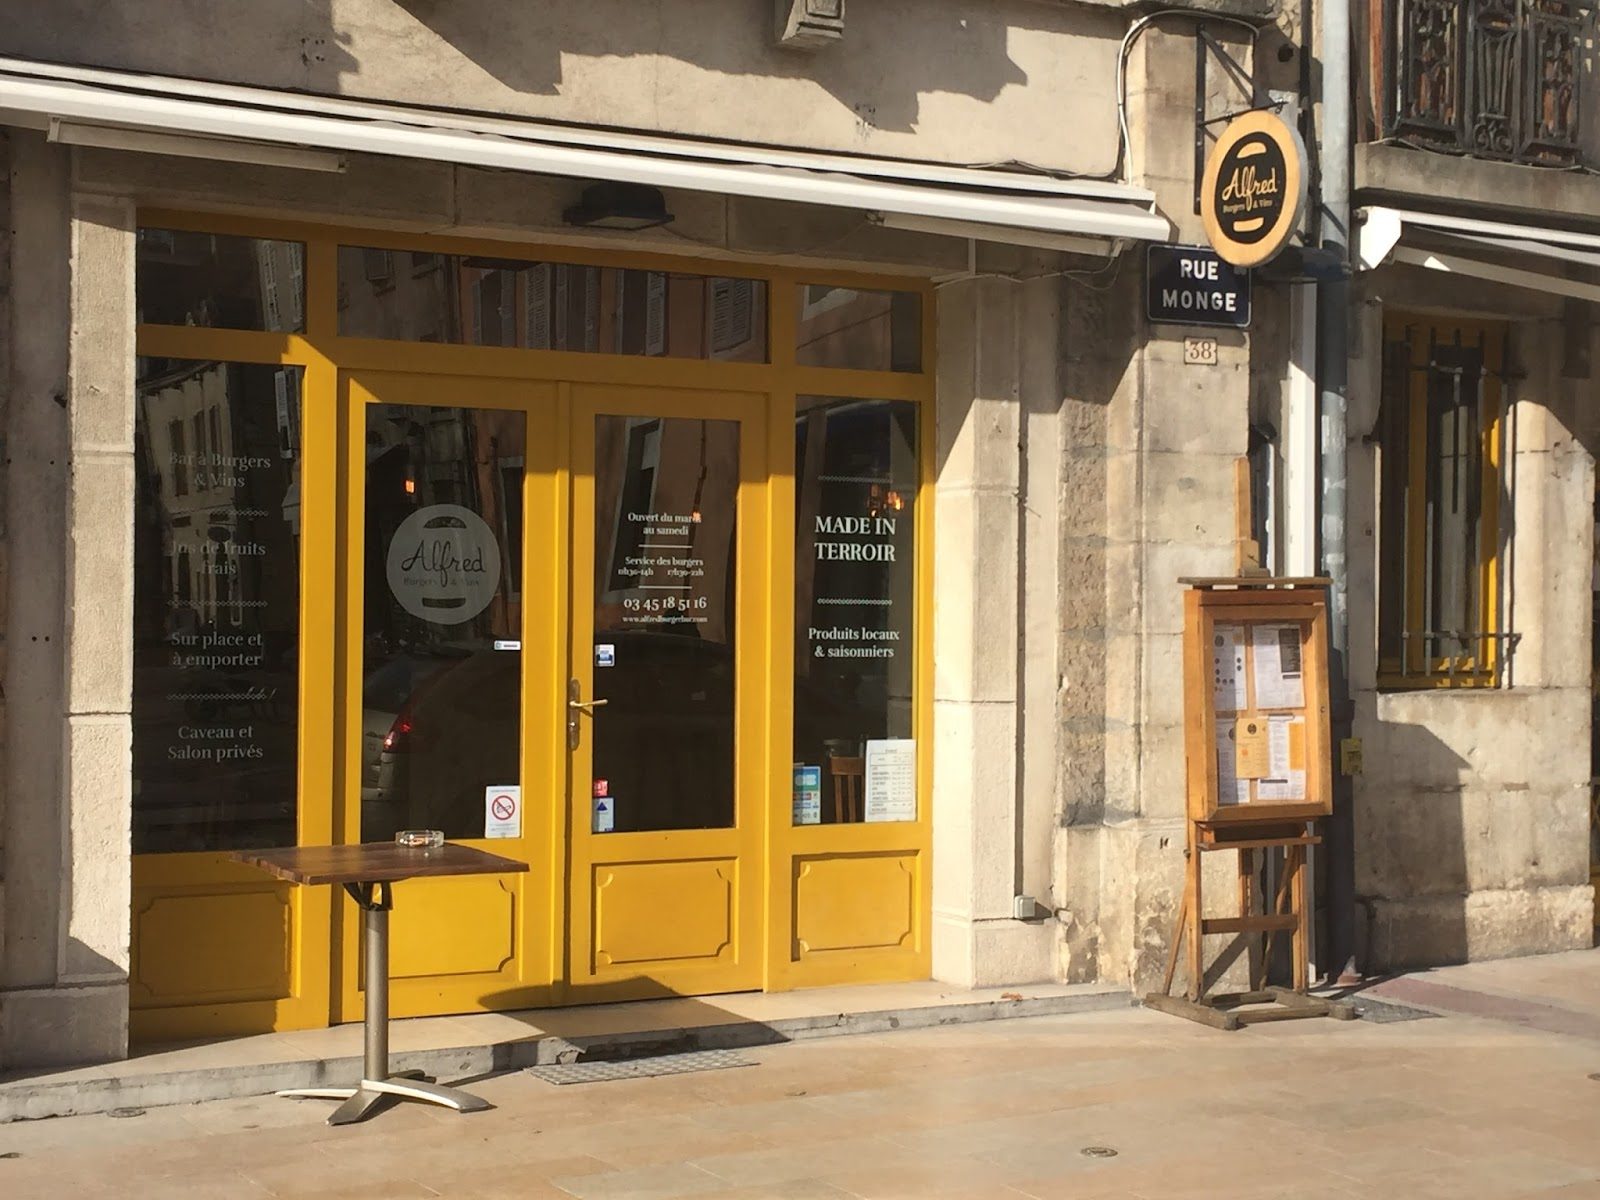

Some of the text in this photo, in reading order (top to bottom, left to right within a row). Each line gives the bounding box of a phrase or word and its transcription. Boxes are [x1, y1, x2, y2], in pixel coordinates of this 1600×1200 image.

[1221, 164, 1278, 212] Alfred
[1180, 258, 1219, 281] RUE
[1162, 288, 1237, 312] MONGE
[1188, 341, 1213, 361] 38
[212, 453, 272, 472] Burgers
[194, 472, 246, 488] & Vins
[627, 511, 659, 523] Ouvert
[660, 512, 673, 523] du
[814, 515, 897, 536] MADE IN
[643, 525, 689, 536] au samedi
[224, 540, 267, 556] fruits
[814, 542, 897, 562] TERROIR
[201, 560, 237, 575] frais
[400, 539, 487, 588] Alfred
[625, 555, 704, 568] Service des burgers
[623, 596, 708, 612] 03 45 18 51 16
[170, 631, 263, 650] Sur place et
[808, 627, 900, 641] Produits locaux
[814, 645, 895, 658] & saisonniers
[185, 653, 262, 670] emporter
[177, 725, 254, 740] Caveau et
[167, 744, 264, 763] Salon privés
